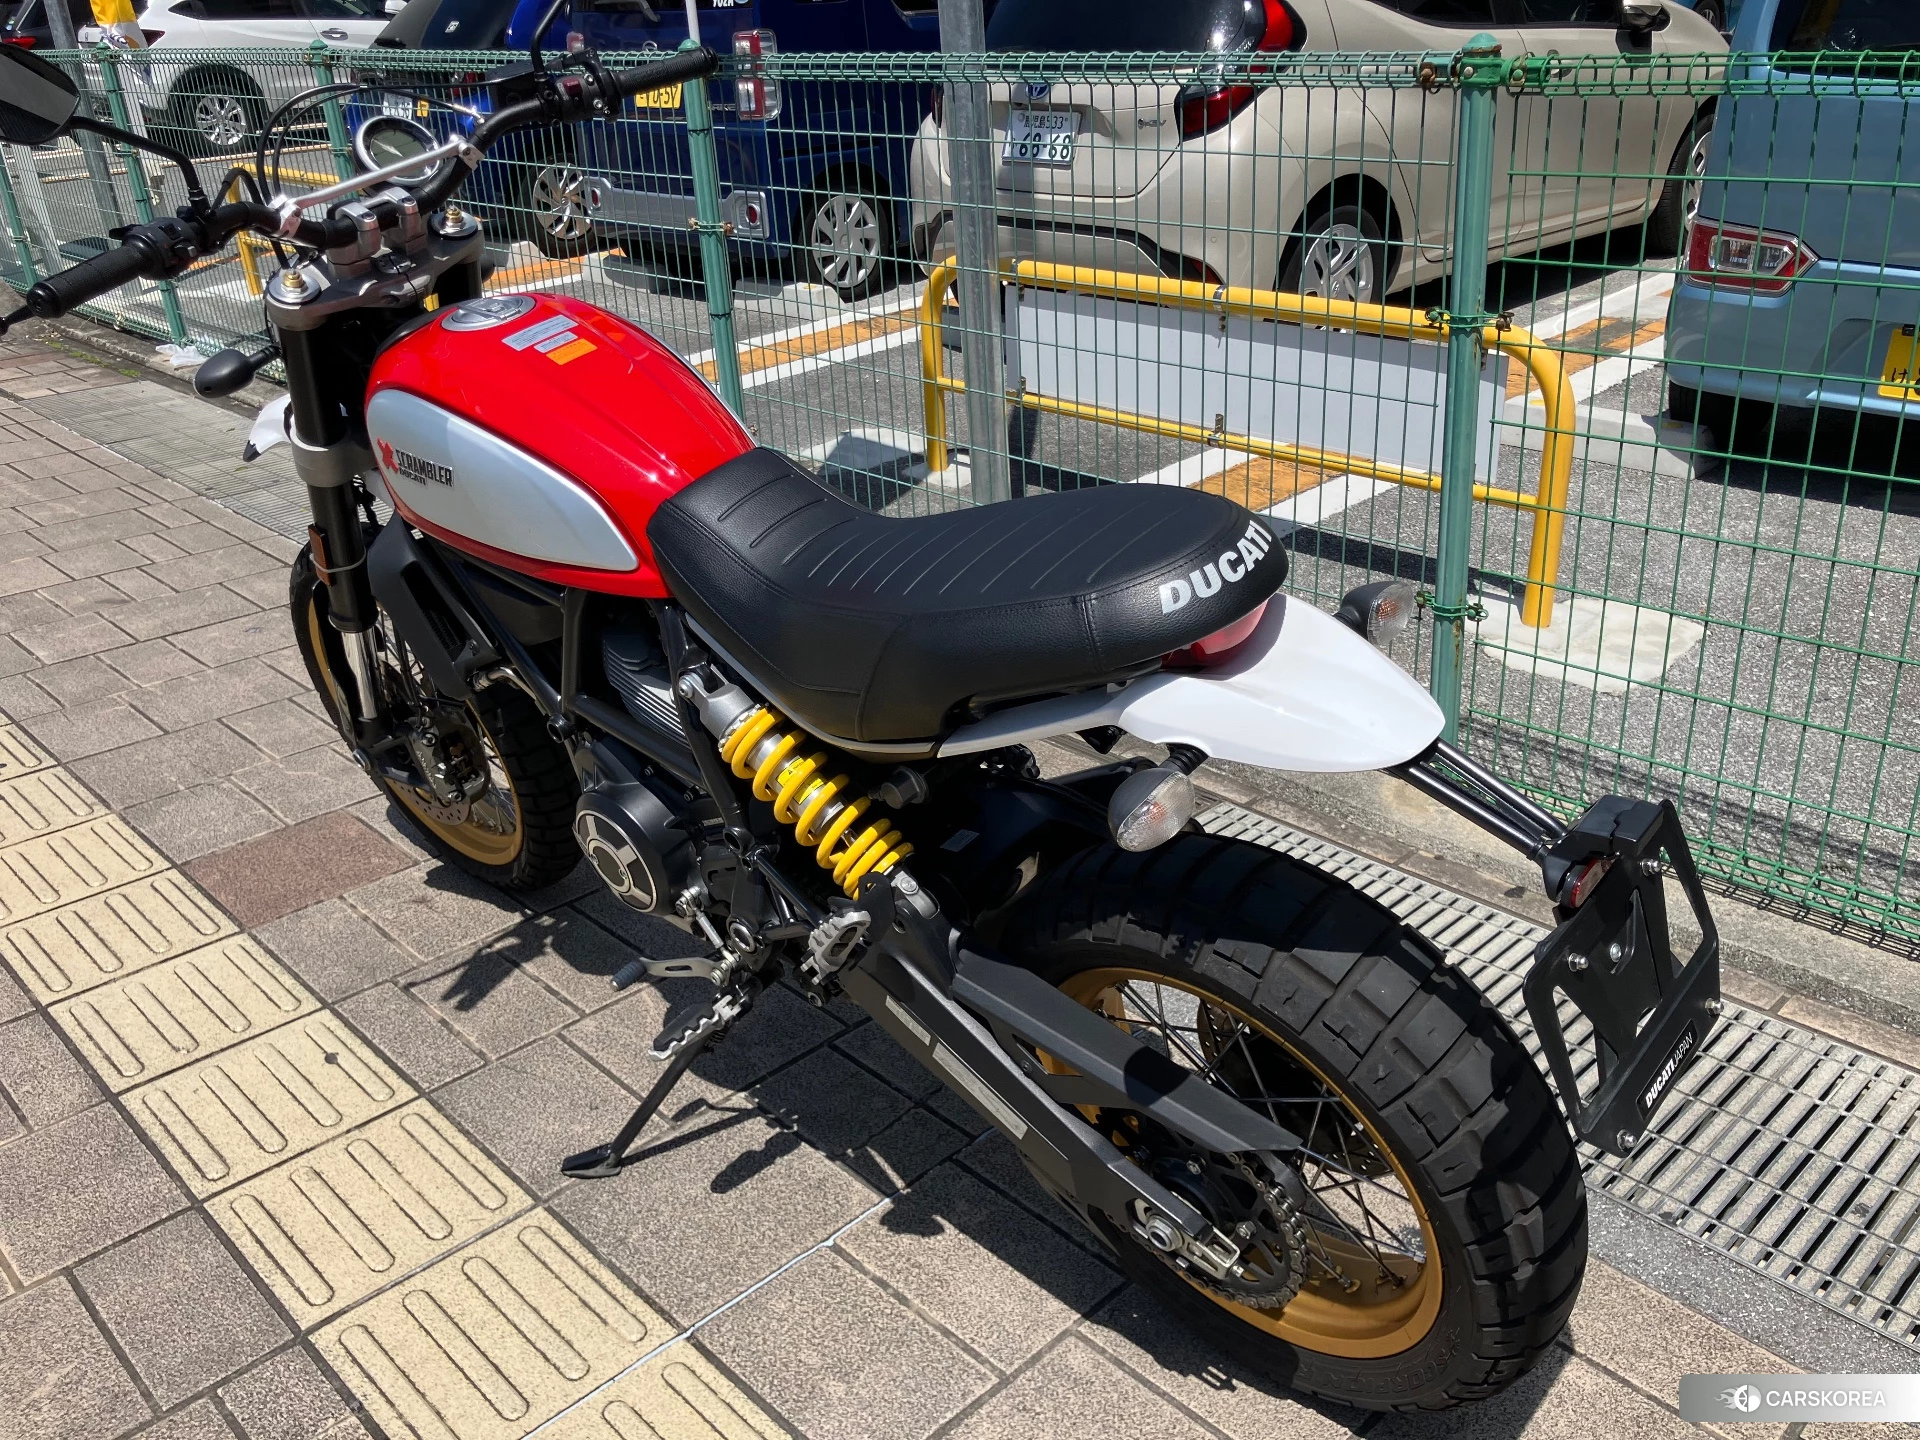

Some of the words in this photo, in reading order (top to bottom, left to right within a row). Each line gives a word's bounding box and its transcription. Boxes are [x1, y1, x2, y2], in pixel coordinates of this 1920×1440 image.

[396, 448, 453, 488] SCRAMBLER
[399, 466, 427, 486] DUCATI
[1159, 519, 1272, 616] DUCATI
[1645, 1058, 1675, 1109] DUCATI
[1673, 1031, 1694, 1068] JAPAN
